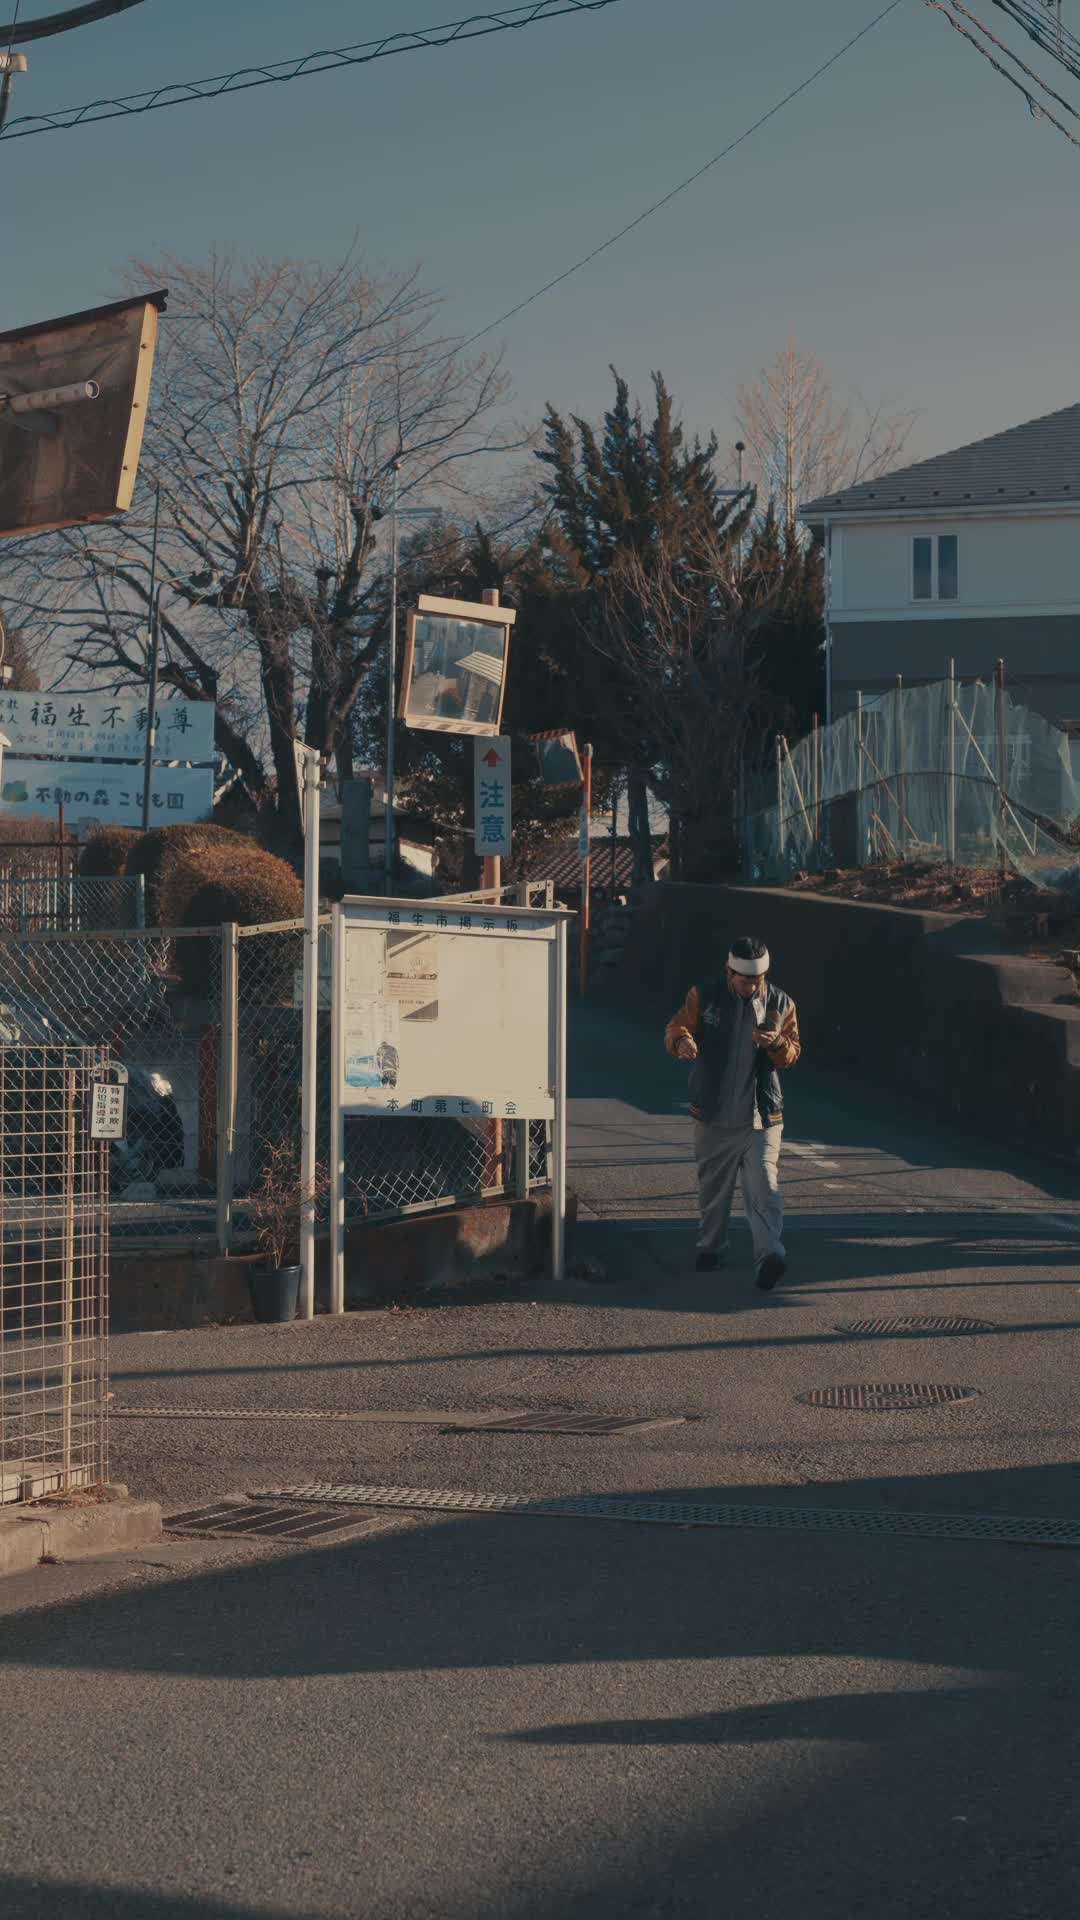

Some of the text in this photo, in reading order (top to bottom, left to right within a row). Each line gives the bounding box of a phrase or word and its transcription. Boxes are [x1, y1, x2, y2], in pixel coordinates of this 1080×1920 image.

[30, 701, 193, 734] 福生不動尊
[35, 787, 185, 810] 不動の森こども園
[480, 780, 505, 843] 注意
[387, 911, 518, 933] 福生市掲示板
[386, 1098, 518, 1115] 本町第七町会
